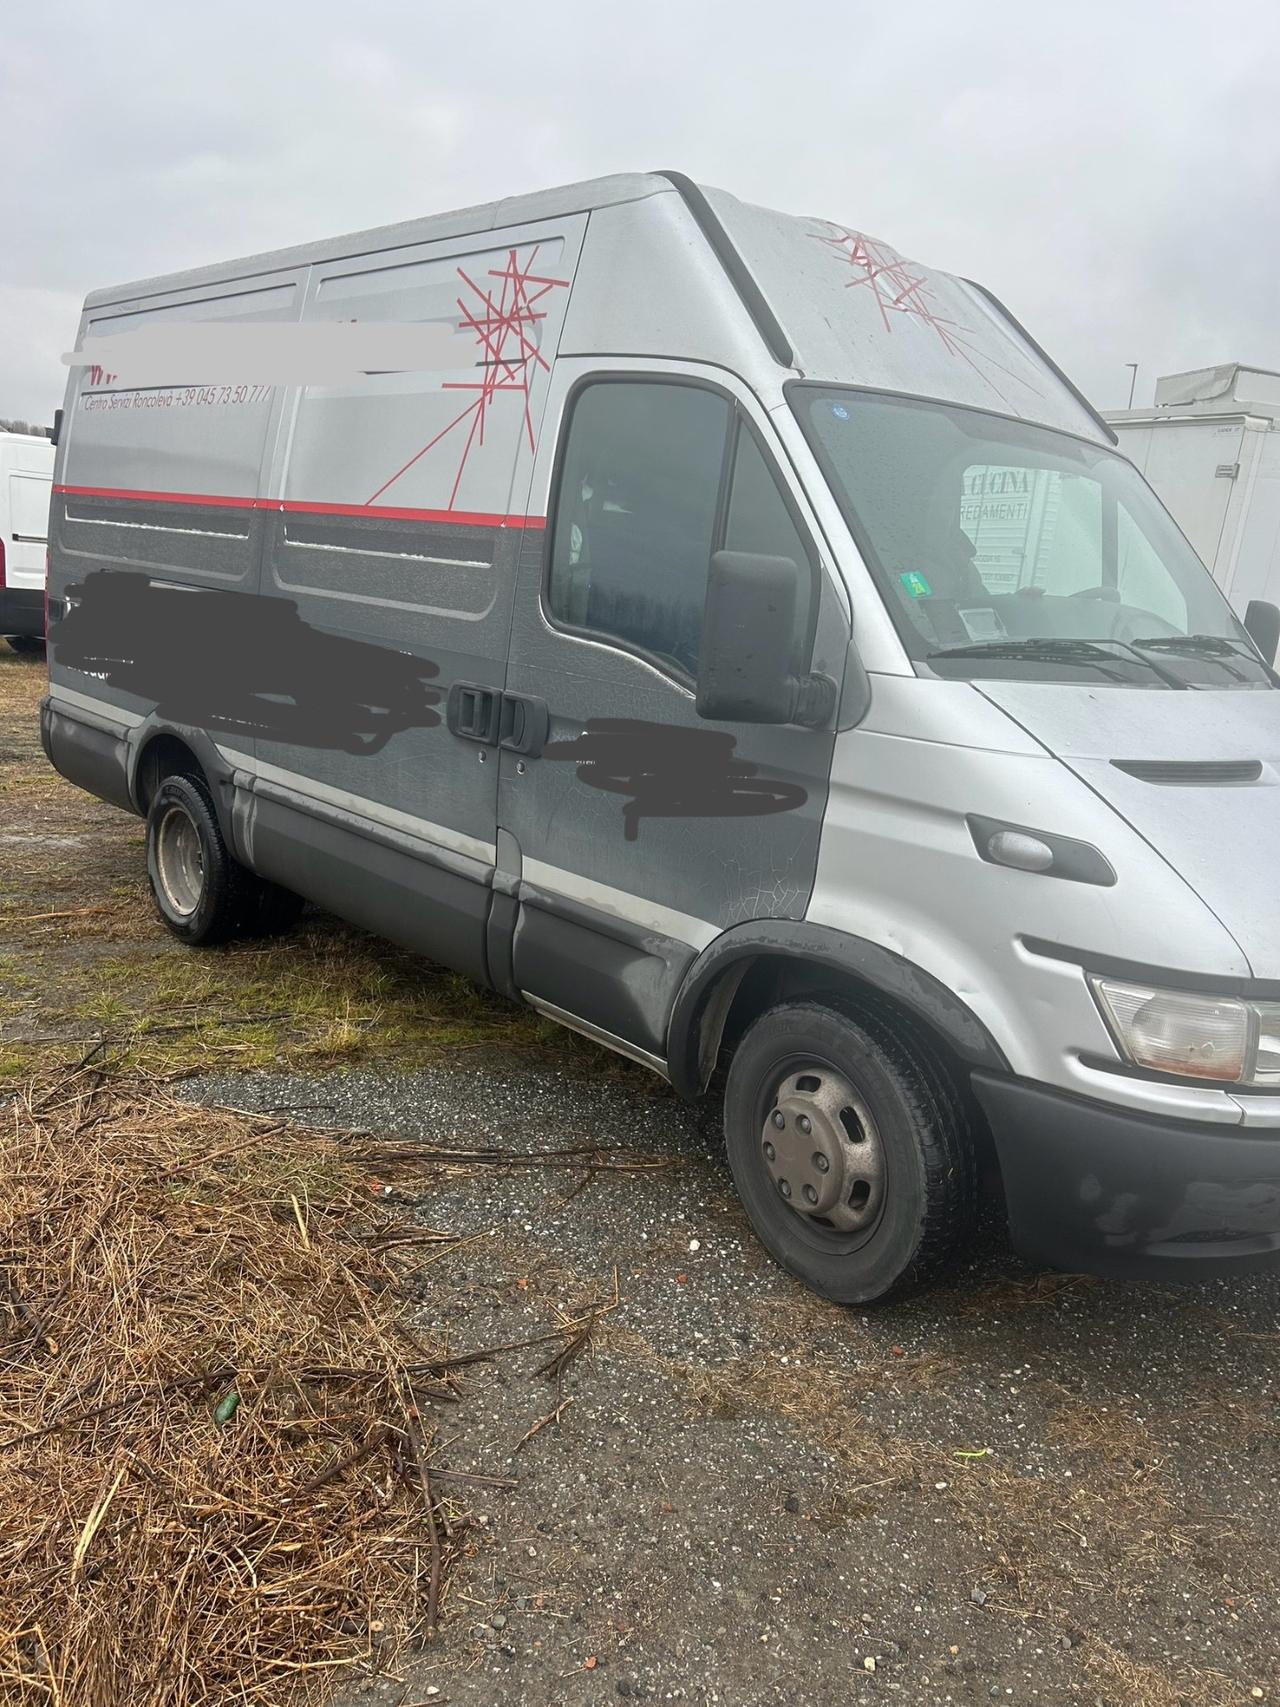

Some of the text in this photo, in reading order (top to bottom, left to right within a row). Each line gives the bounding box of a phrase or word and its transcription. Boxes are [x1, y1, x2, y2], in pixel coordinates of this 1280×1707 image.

[85, 394, 108, 411] Centro
[108, 393, 132, 409] Servizi
[175, 388, 196, 406] +39
[196, 387, 217, 405] 045
[217, 386, 232, 404] 73
[232, 385, 248, 404] 50
[970, 470, 1029, 495] CUCINA
